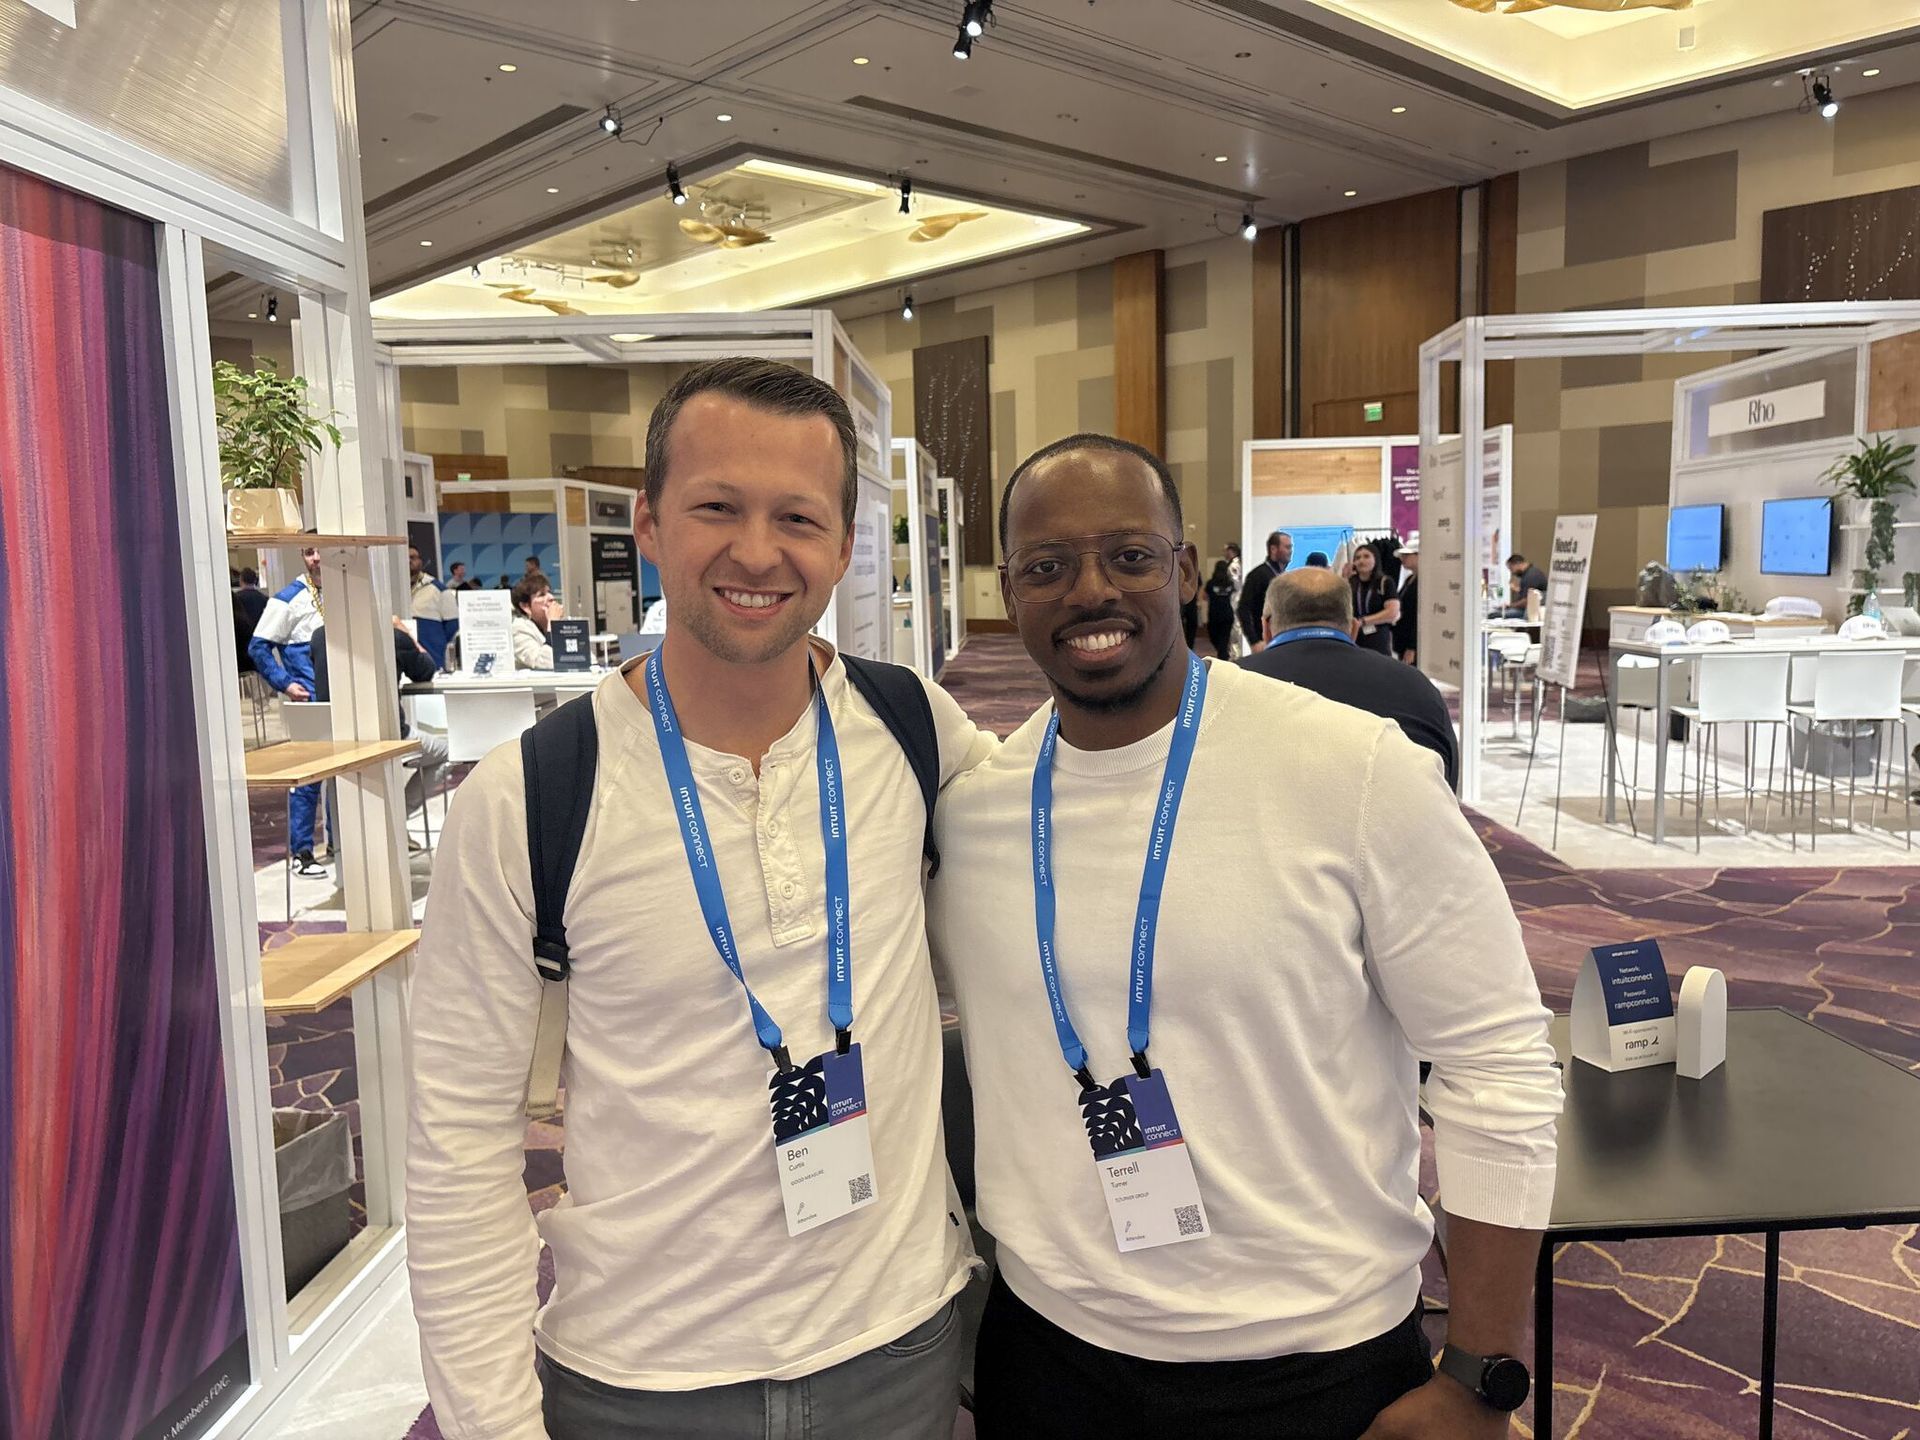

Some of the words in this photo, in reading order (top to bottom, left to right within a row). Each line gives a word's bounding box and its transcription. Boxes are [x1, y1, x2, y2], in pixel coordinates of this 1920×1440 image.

[1749, 399, 1775, 425] Rho
[1611, 973, 1653, 984] intuitconnect
[1614, 997, 1659, 1008] rampconnects
[1625, 1039, 1649, 1050] ramp
[787, 1147, 809, 1162] Ben
[1107, 1162, 1139, 1178] Terrell
[1111, 1180, 1128, 1189] Turner
[171, 1396, 209, 1438] Members
